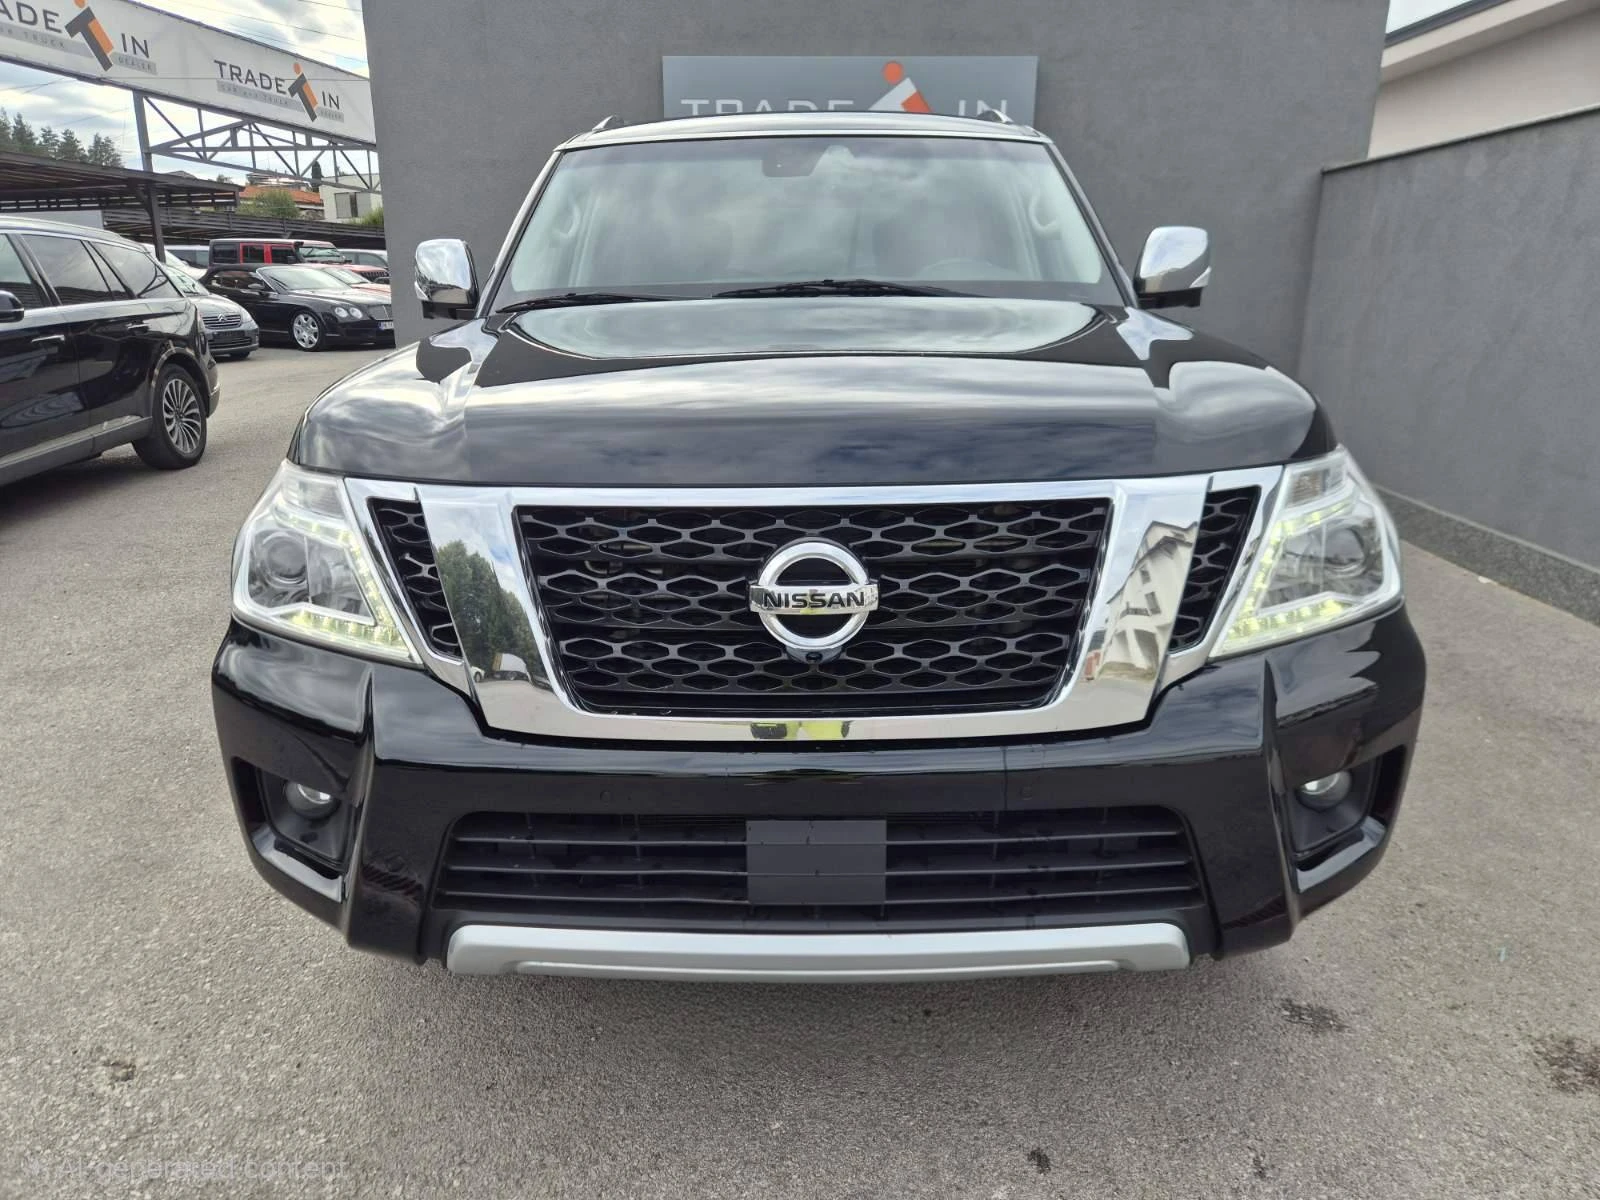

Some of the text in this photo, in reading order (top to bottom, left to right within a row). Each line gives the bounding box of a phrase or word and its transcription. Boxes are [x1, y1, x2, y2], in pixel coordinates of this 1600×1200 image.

[121, 32, 150, 59] IN
[214, 59, 340, 110] TRADE IN
[763, 591, 865, 609] NISSAN
